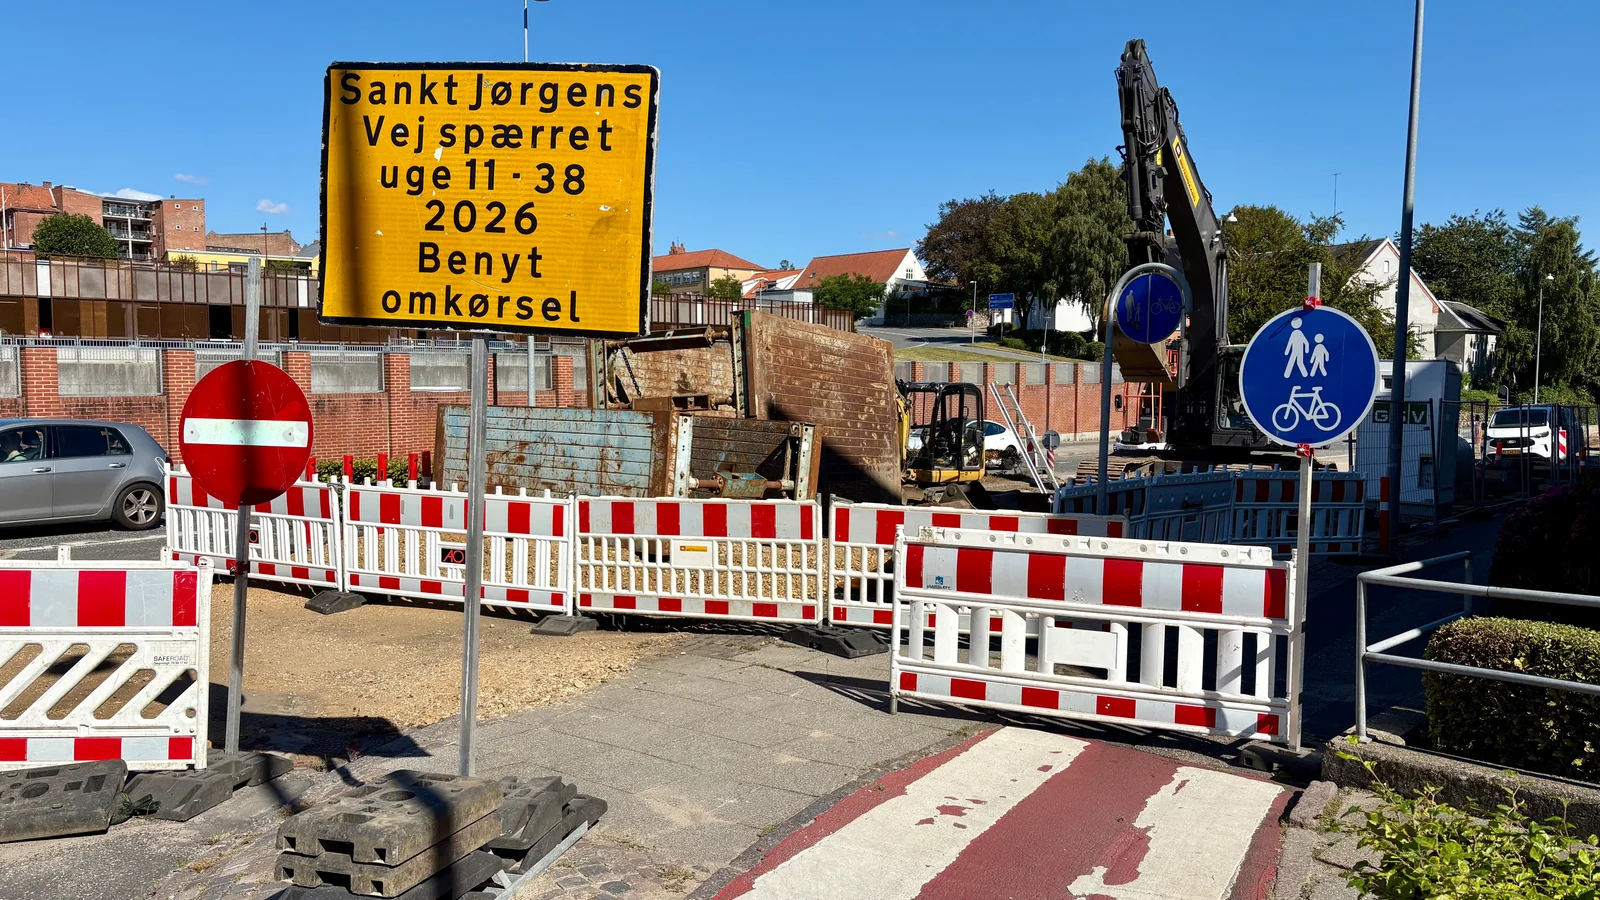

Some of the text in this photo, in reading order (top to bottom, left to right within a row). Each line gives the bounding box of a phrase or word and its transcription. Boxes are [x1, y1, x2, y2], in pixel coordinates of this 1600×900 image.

[340, 73, 641, 113] Sankt Jørgens
[363, 115, 613, 154] Vej spærret
[381, 165, 451, 195] uge
[465, 159, 495, 191] 11
[534, 162, 586, 195] 38
[425, 200, 538, 235] 2026
[419, 242, 543, 283] Benyt
[382, 285, 580, 323] omkørsel
[443, 550, 464, 564] AO
